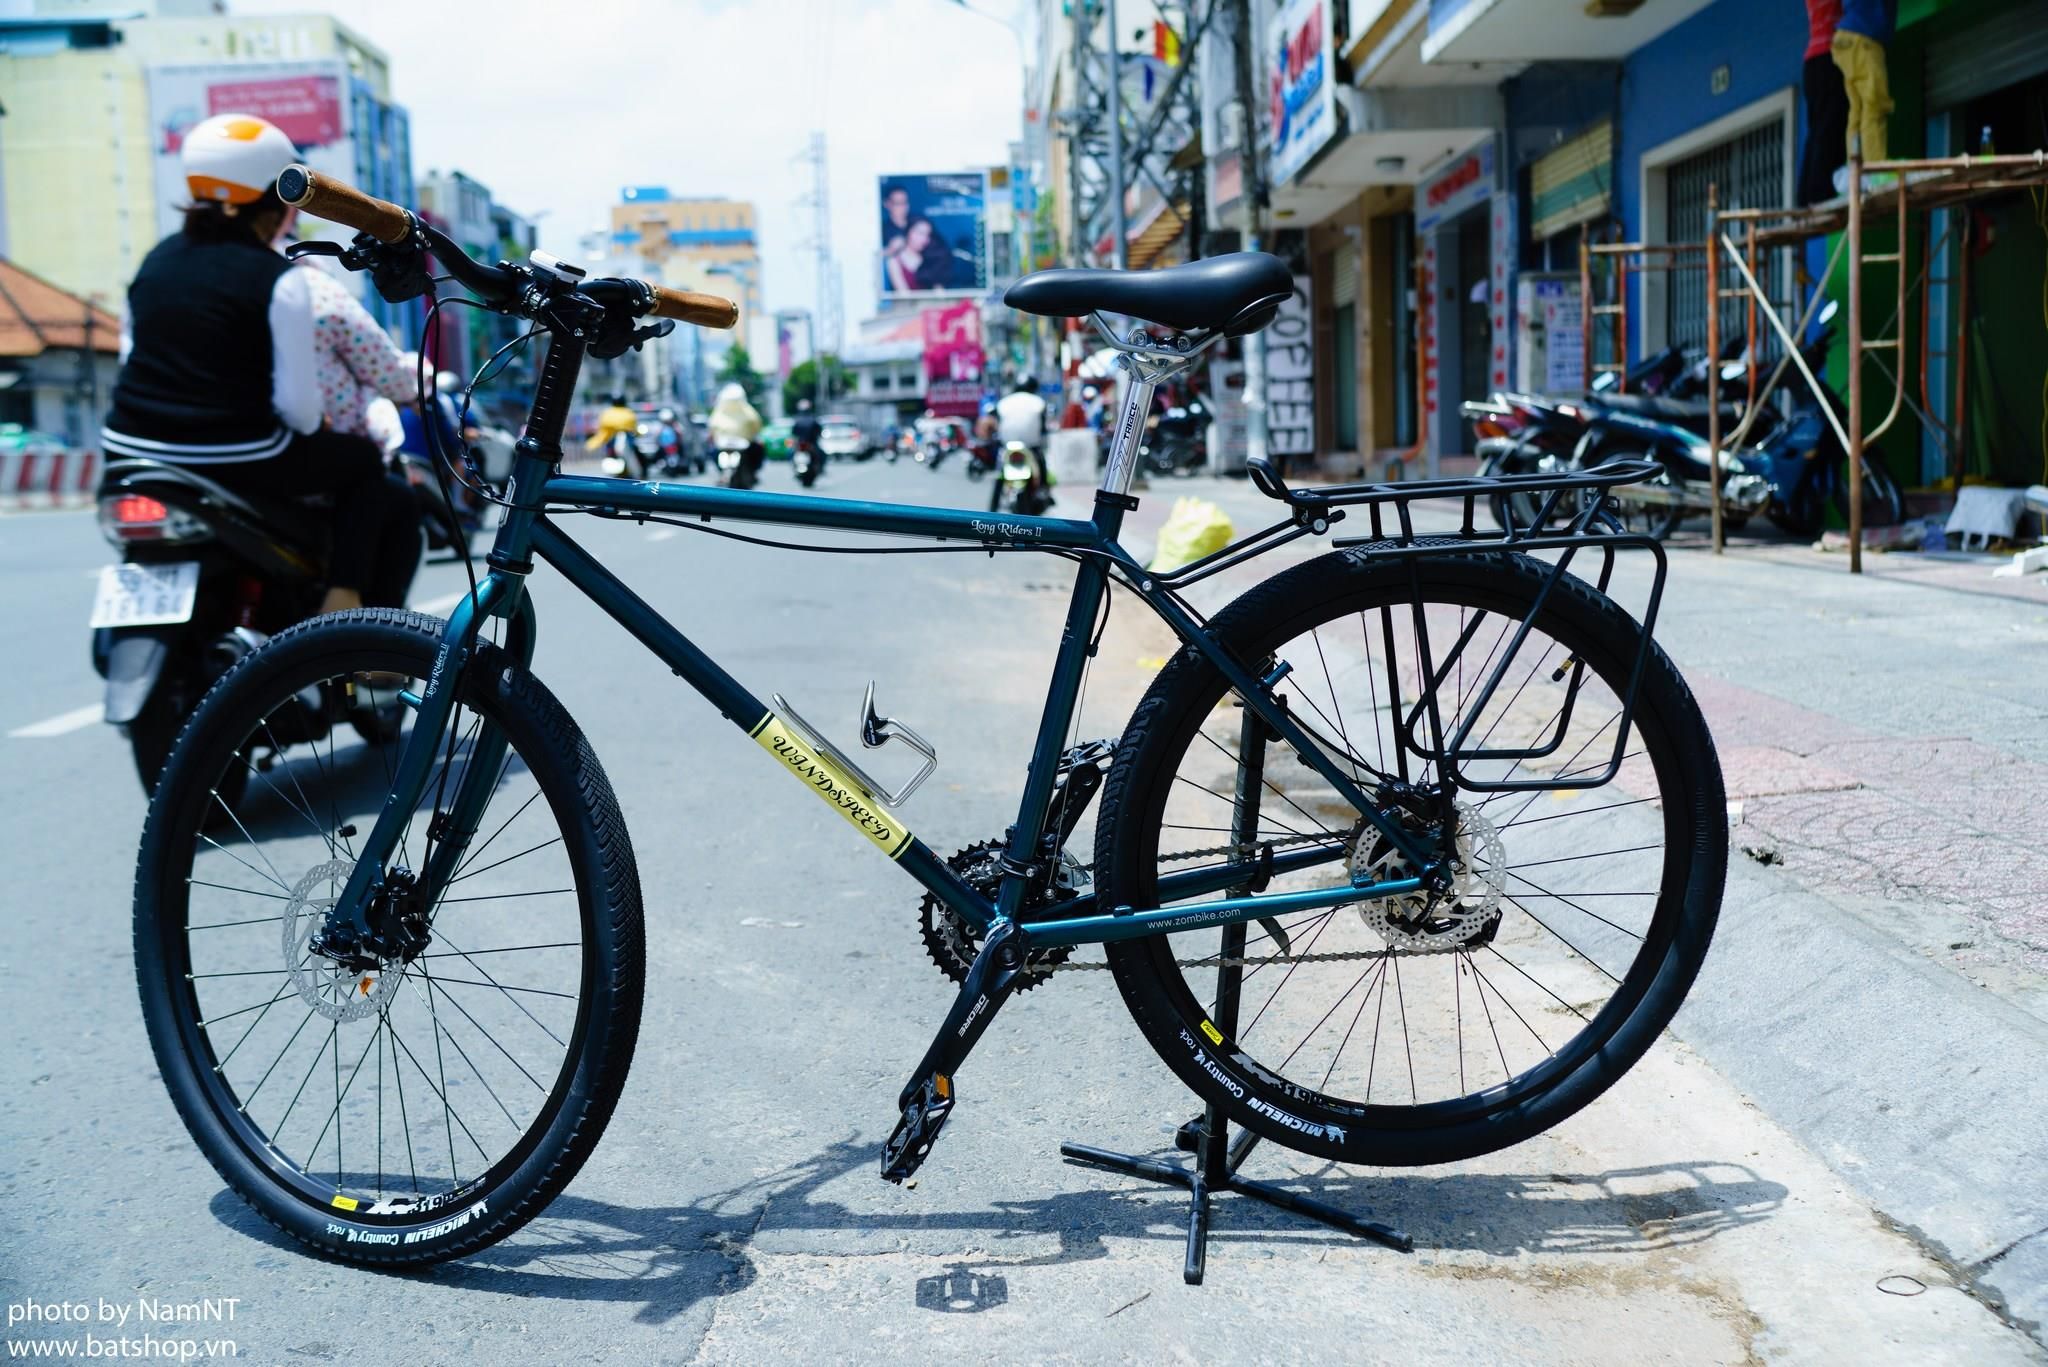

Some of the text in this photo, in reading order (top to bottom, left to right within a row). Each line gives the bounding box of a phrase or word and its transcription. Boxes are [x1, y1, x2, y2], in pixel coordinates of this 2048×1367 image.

[971, 519, 1042, 538] Long Riders II
[432, 650, 448, 678] Riders
[426, 678, 440, 698] Long
[773, 735, 891, 841] WINDSPEED
[1147, 908, 1241, 929] www.zombike.com
[957, 993, 987, 1038] DEORE
[1180, 1028, 1197, 1050] rock
[1203, 1061, 1244, 1099] Country
[1246, 1096, 1326, 1138] MICHELIN
[326, 1211, 472, 1246] MICHELIN Country rock
